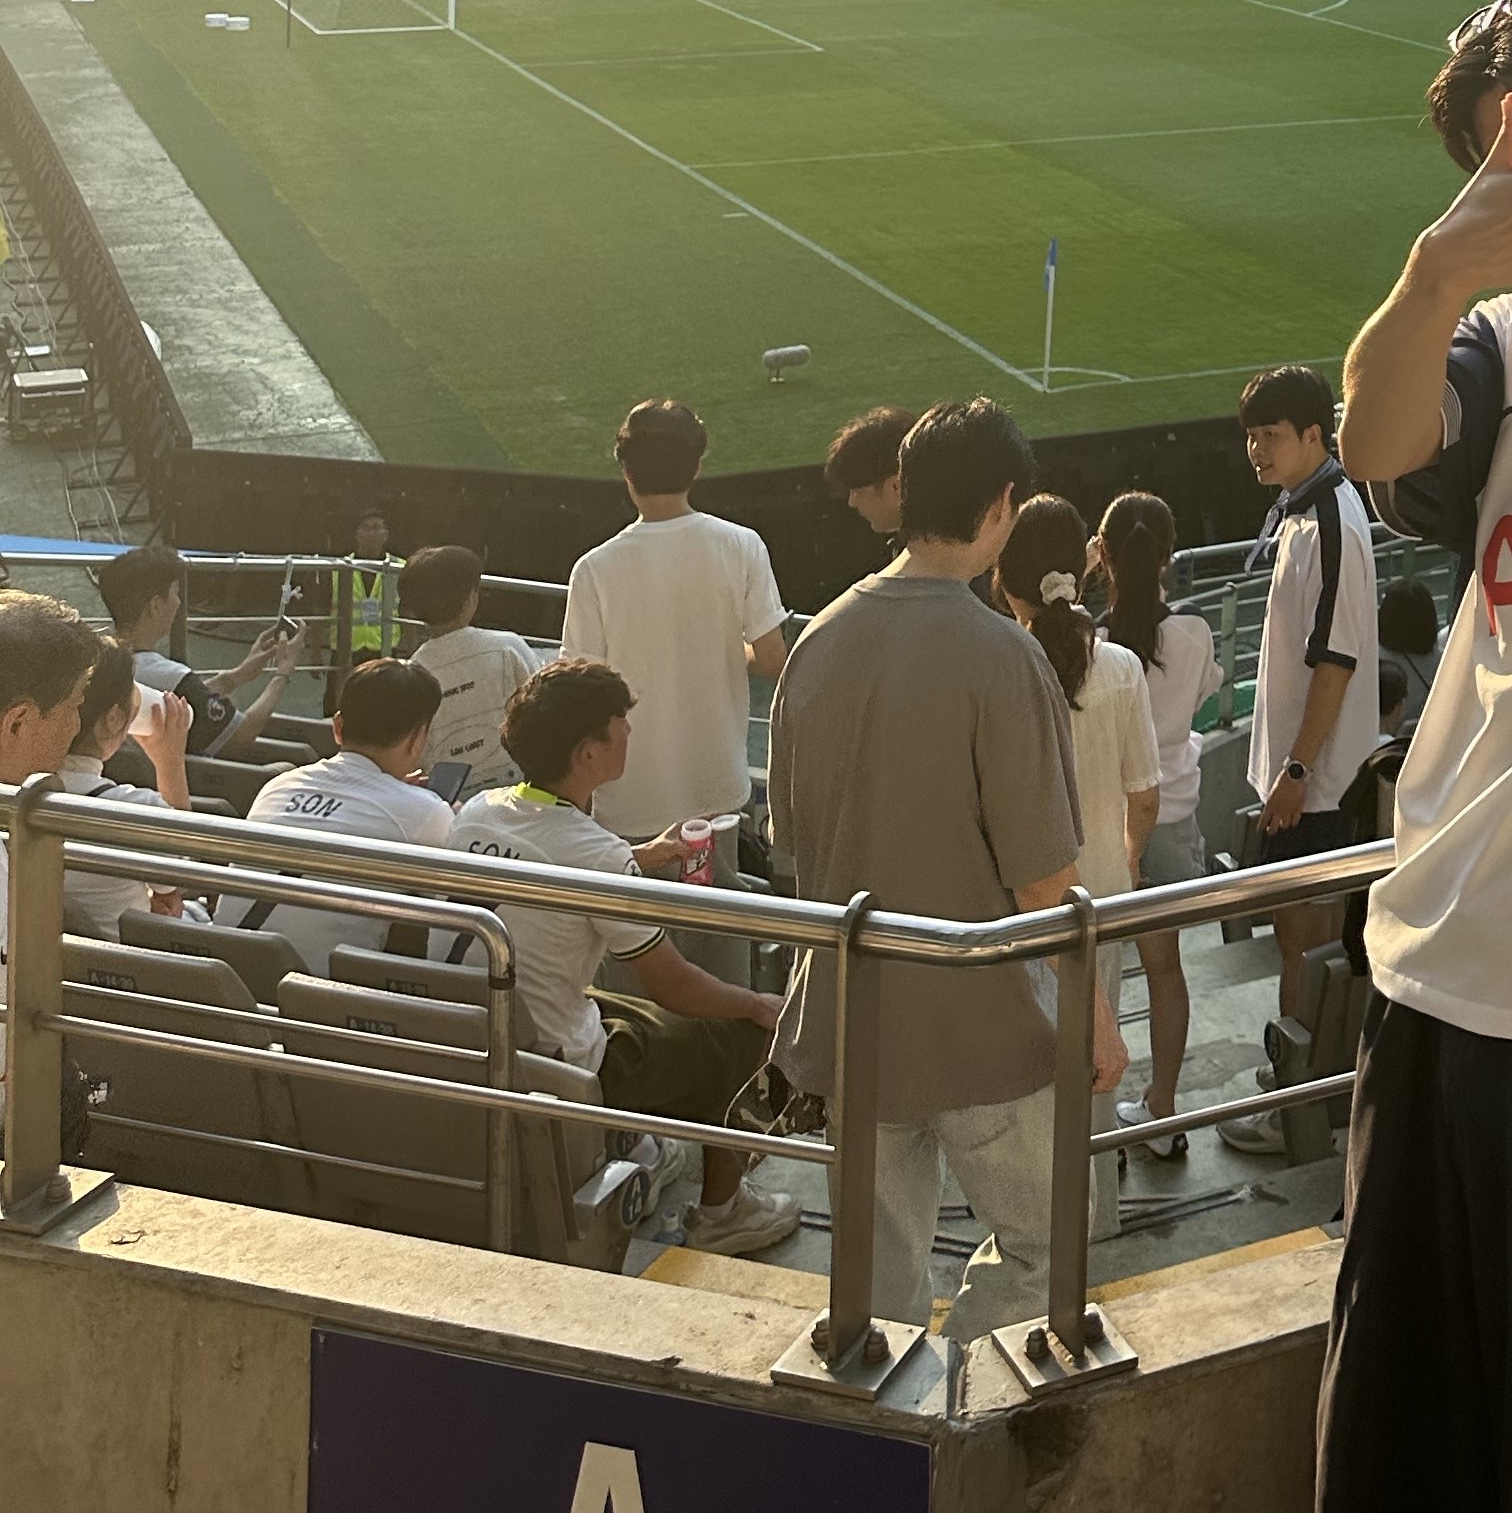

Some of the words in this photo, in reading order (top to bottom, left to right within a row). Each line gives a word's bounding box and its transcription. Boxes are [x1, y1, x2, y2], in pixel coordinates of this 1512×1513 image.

[286, 794, 343, 818] SON
[631, 1174, 641, 1199] A
[571, 1441, 645, 1513] A
